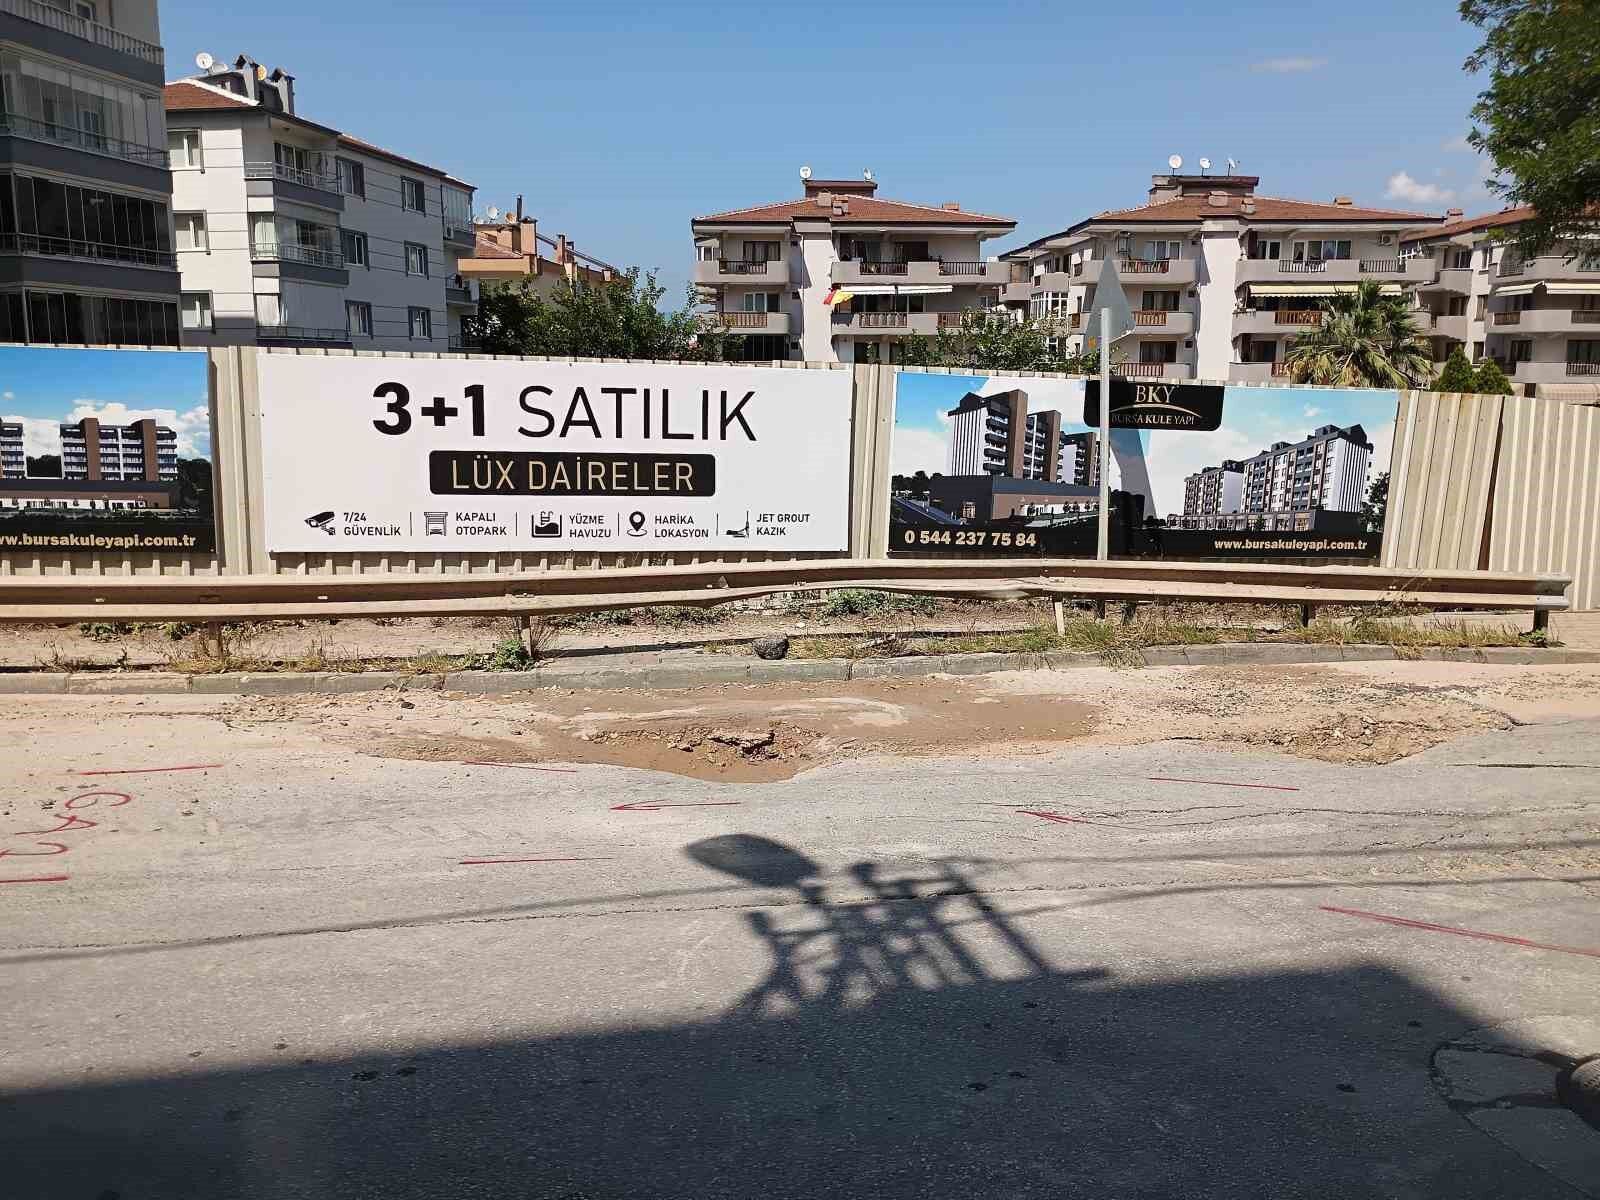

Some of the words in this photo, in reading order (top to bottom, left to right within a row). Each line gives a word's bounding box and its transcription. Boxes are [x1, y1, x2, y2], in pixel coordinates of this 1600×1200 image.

[1135, 385, 1175, 403] BKY
[372, 382, 487, 438] 3+1
[518, 384, 757, 441] SATILIK
[1111, 414, 1143, 424] BURSA
[1145, 414, 1172, 424] KULE
[1174, 415, 1195, 425] YAPI
[452, 456, 515, 490] LÜX
[528, 456, 694, 491] DAİRELER
[343, 512, 367, 523] 7/24
[455, 512, 496, 522] KAPALI
[569, 513, 604, 525] YÜZME
[654, 513, 694, 525] HARİKA
[756, 513, 776, 523] JET
[777, 513, 811, 523] GROUT
[343, 524, 401, 536] GÜVENLİK
[455, 525, 508, 536] OTOPARK
[569, 528, 612, 538] HAVUZU
[654, 528, 709, 538] LOKASYON
[756, 526, 787, 536] KAZIK
[904, 530, 915, 544] 0
[920, 530, 951, 545] 544
[955, 531, 986, 546] 237
[991, 532, 1012, 546] 75
[1015, 533, 1037, 547] 84
[1214, 538, 1368, 551] www.bursakuleyapi.com.tr
